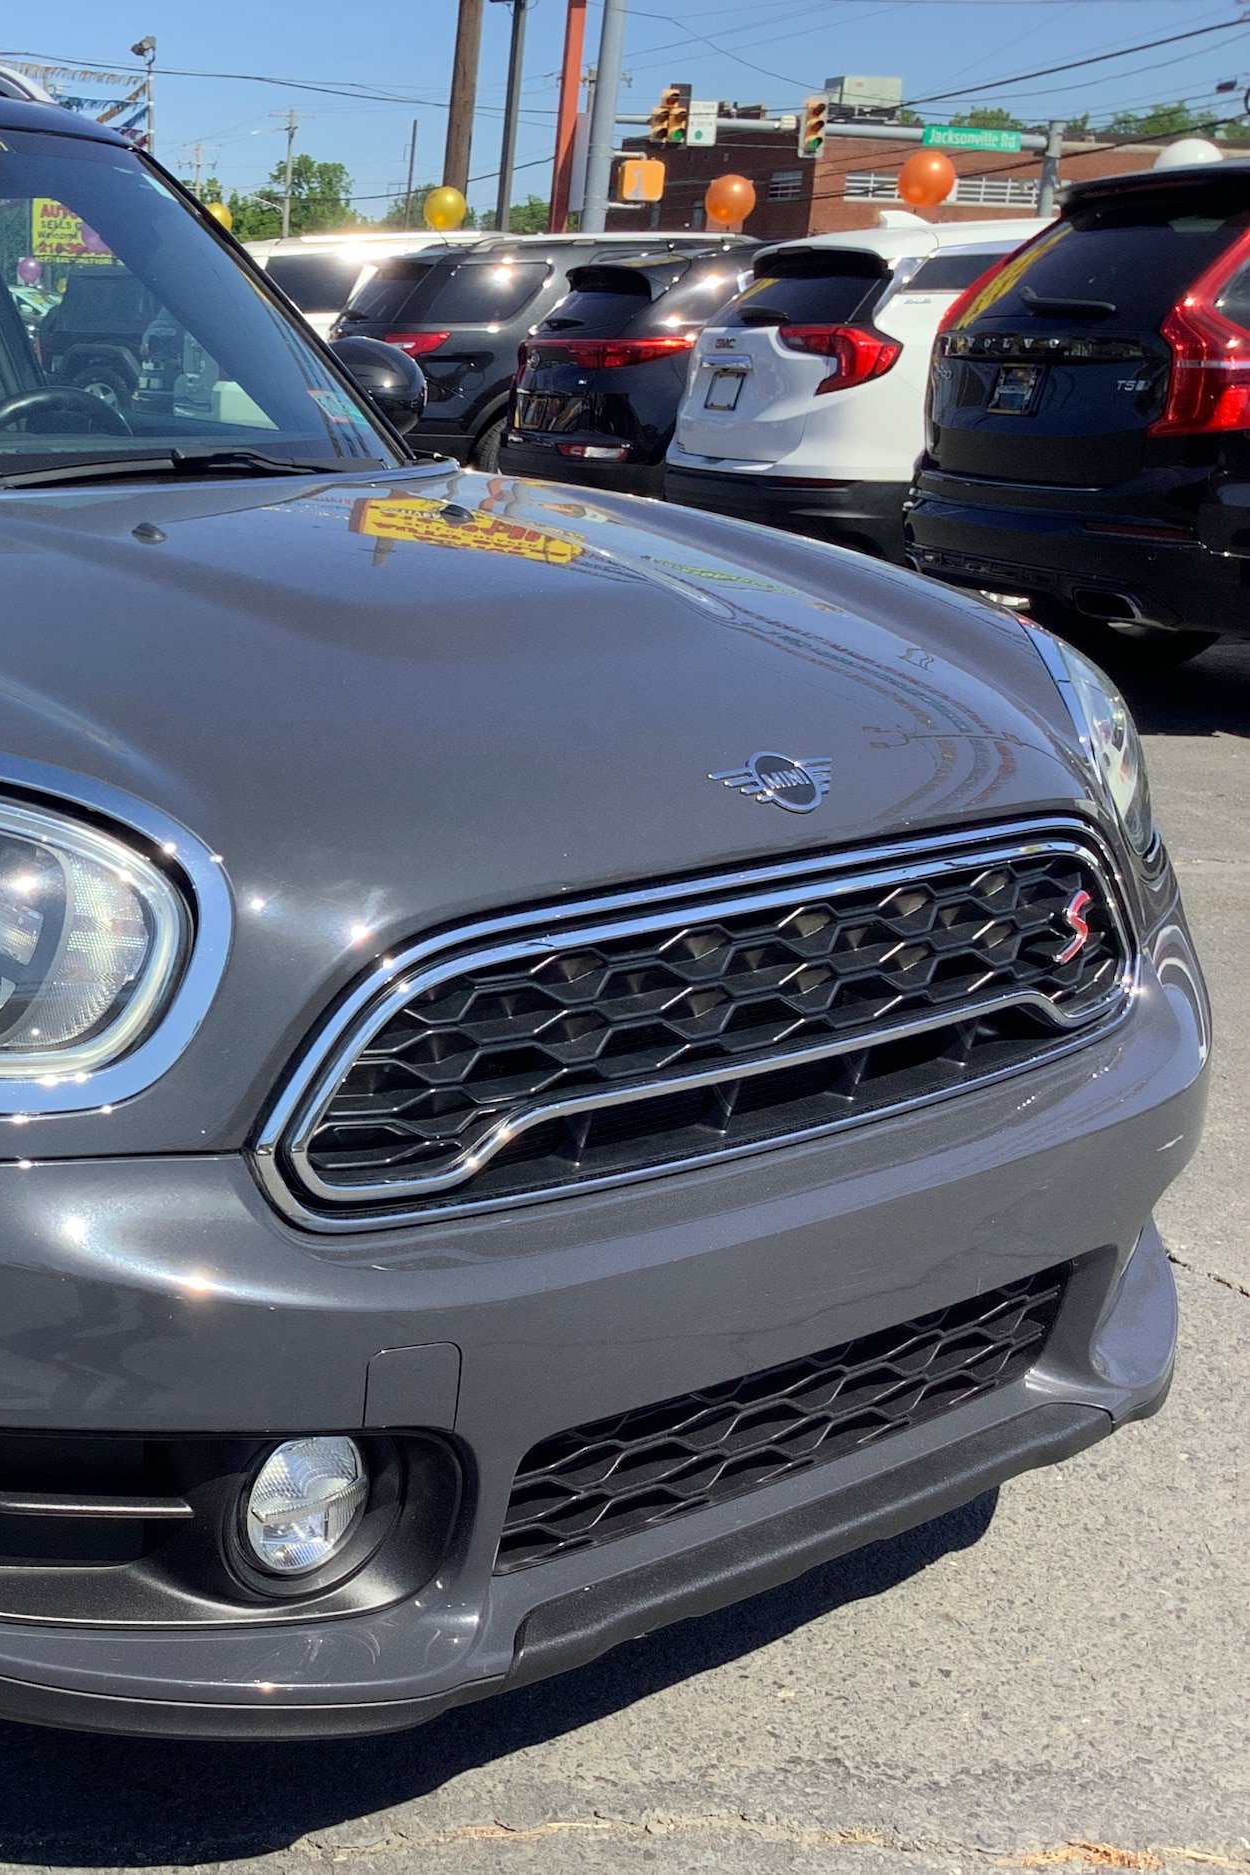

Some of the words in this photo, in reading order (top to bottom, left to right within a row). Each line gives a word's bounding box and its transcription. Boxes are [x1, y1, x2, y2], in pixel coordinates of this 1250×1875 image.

[928, 128, 998, 147] Jacksonville
[1000, 132, 1016, 149] Rd
[965, 336, 1060, 350] VOLVO
[760, 769, 810, 789] MINI
